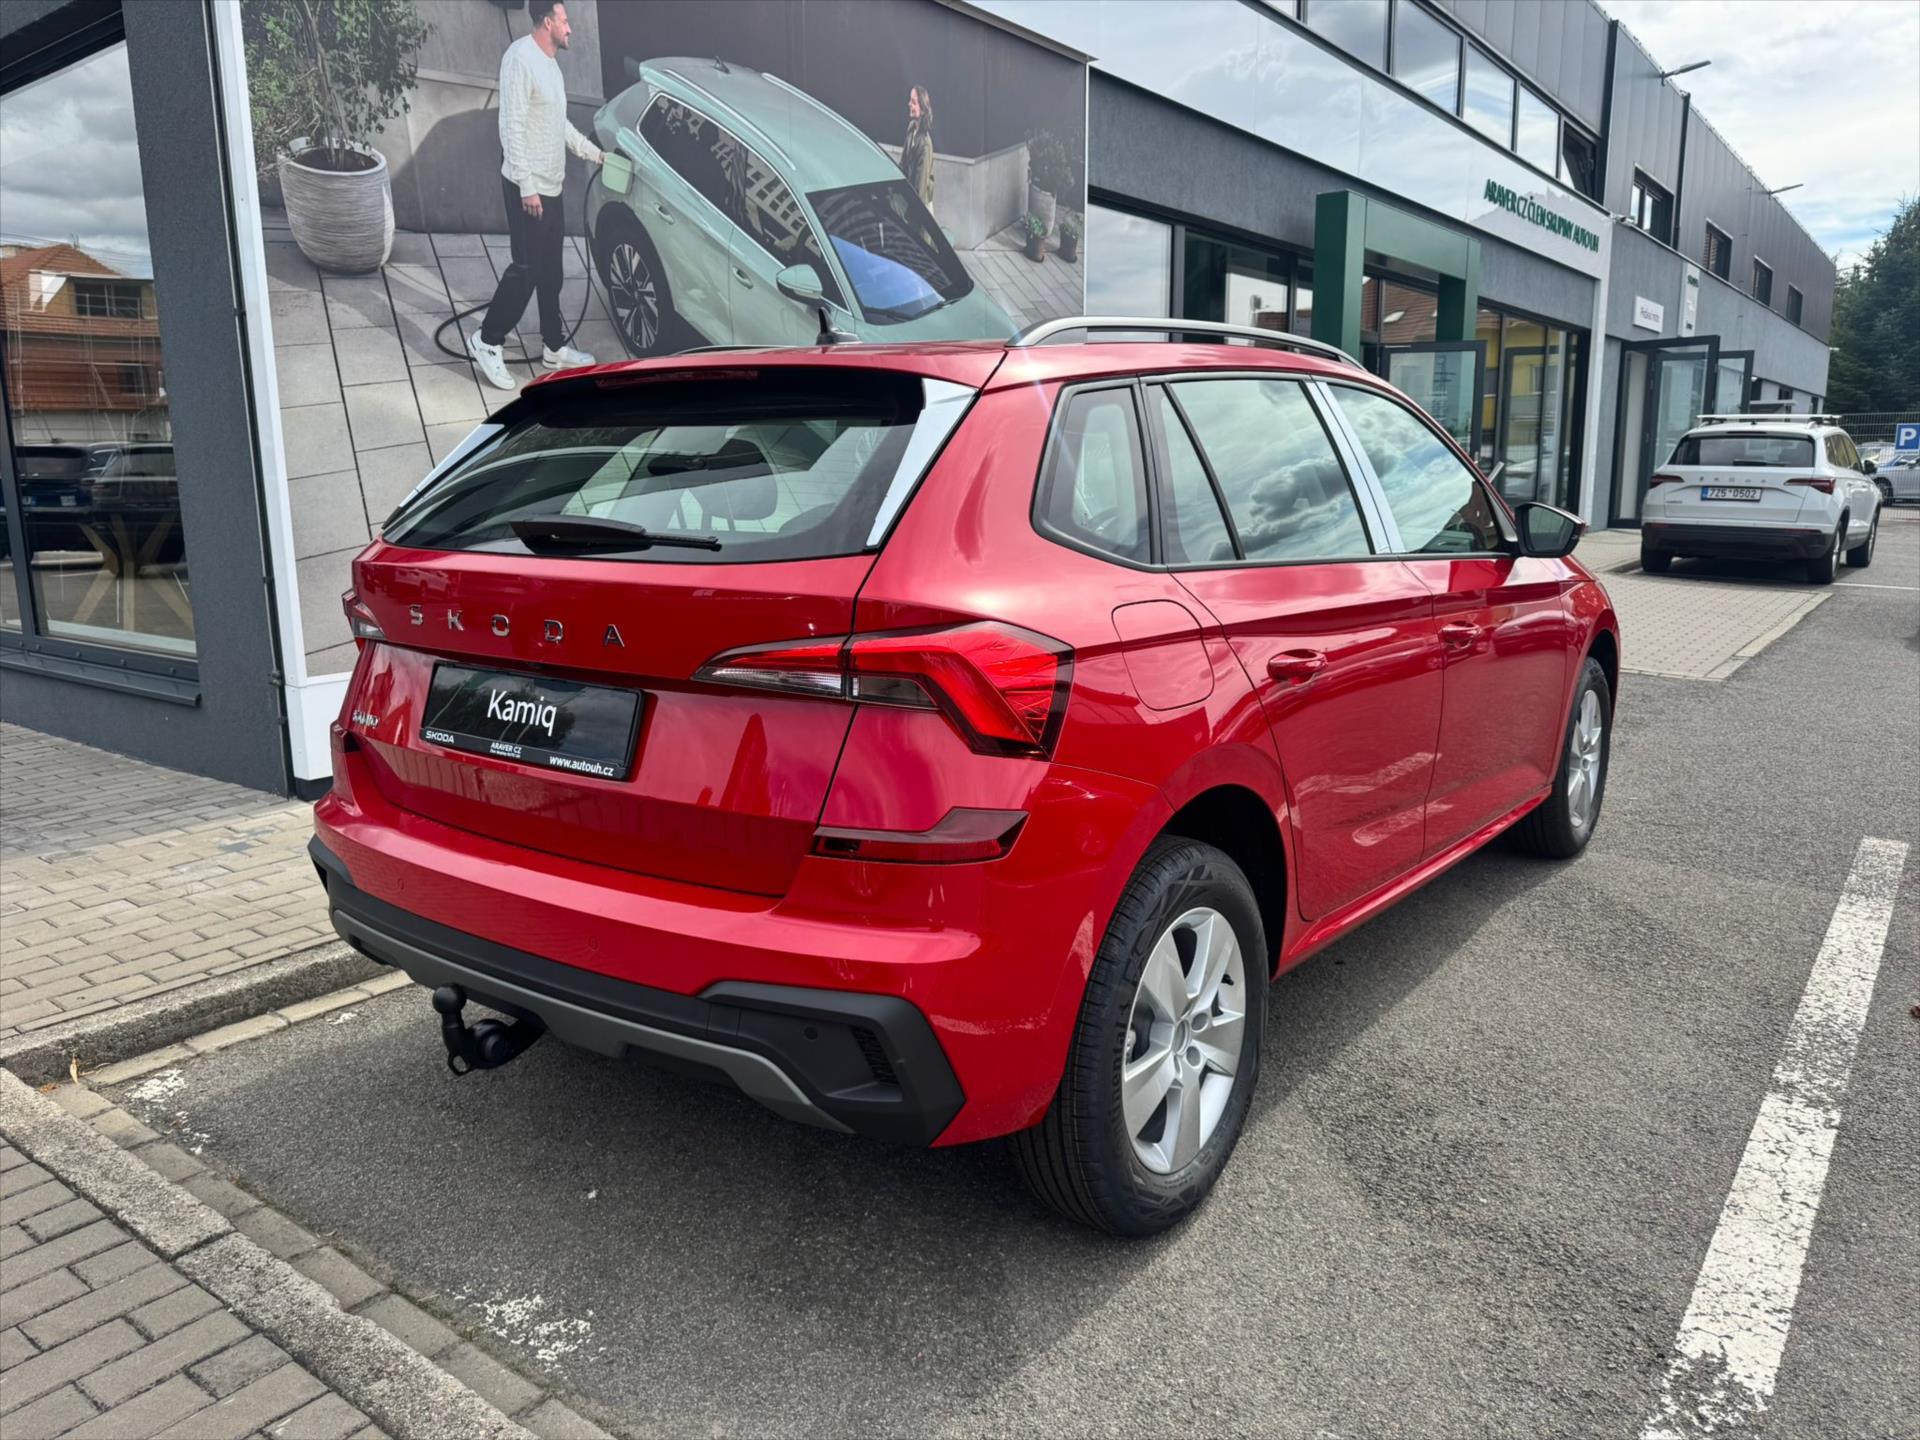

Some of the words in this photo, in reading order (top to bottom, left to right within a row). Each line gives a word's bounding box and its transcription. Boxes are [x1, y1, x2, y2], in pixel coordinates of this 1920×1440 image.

[1484, 178, 1517, 214] ARAVER
[1516, 195, 1528, 219] CZ
[1899, 427, 1917, 447] P
[1732, 488, 1757, 499] 0502
[487, 689, 557, 737] Kamiq
[490, 742, 513, 753] ARAVER
[513, 746, 523, 754] CZ
[549, 755, 614, 776] www.autouh.cz
